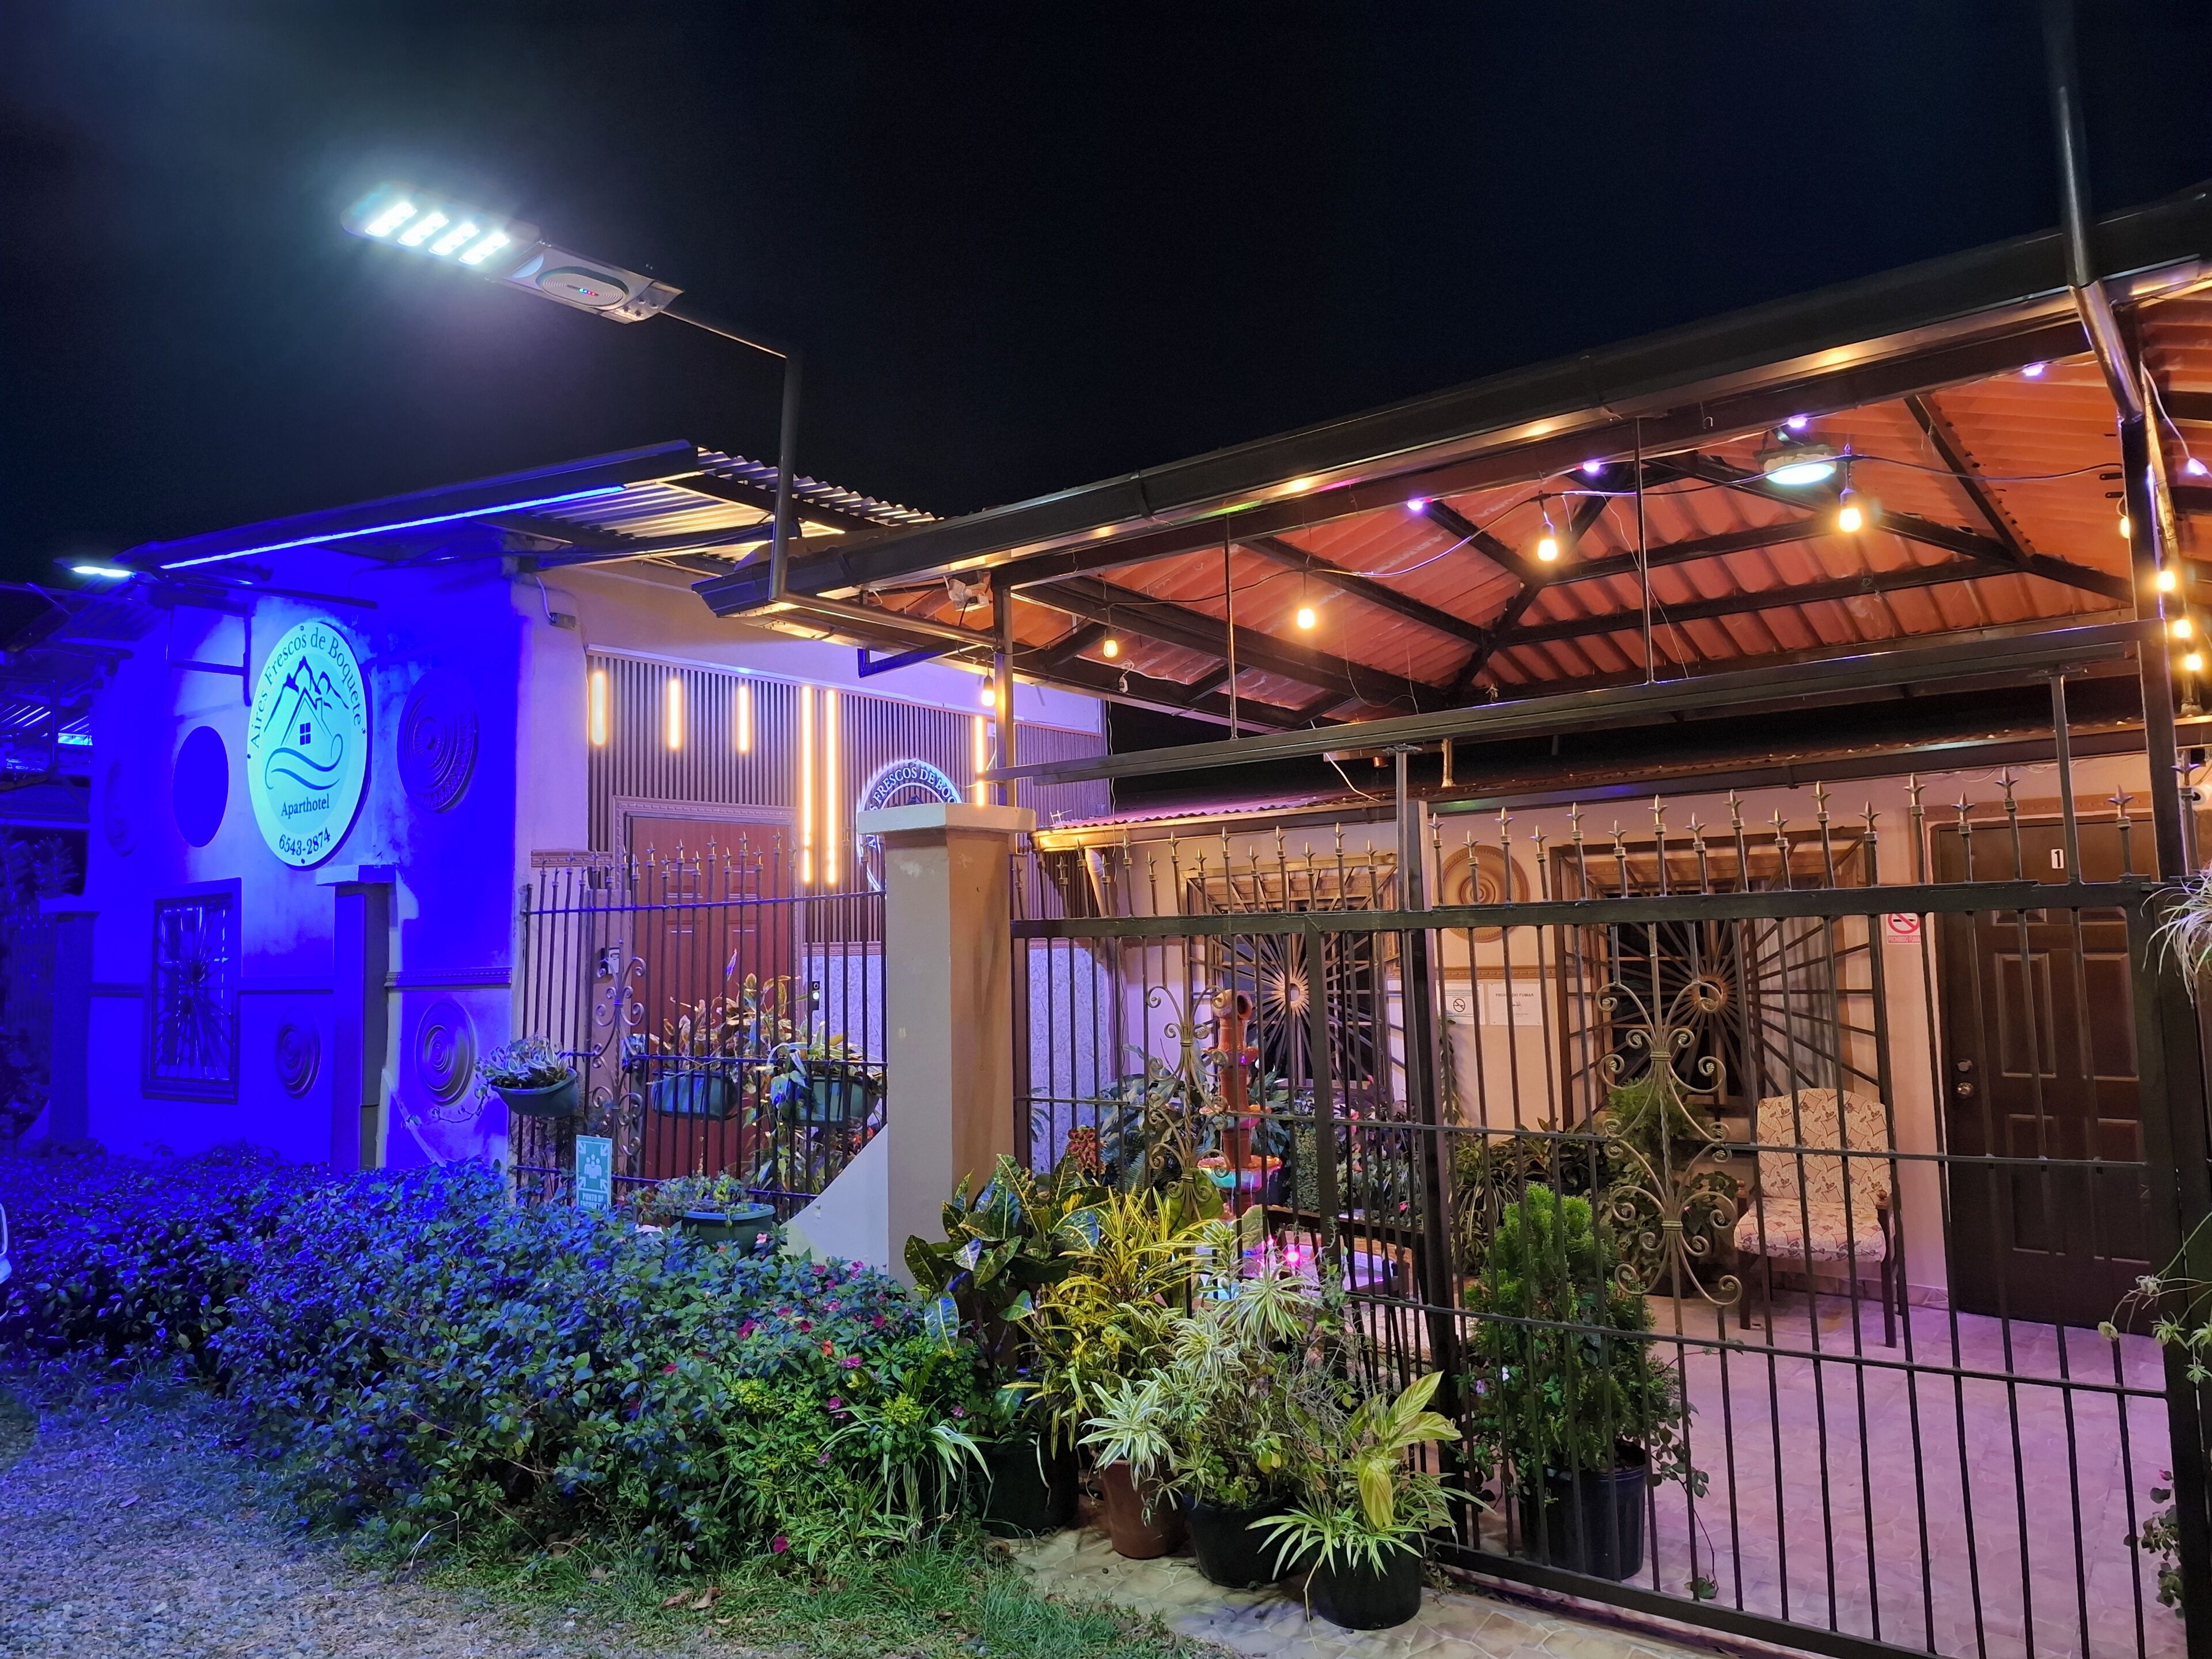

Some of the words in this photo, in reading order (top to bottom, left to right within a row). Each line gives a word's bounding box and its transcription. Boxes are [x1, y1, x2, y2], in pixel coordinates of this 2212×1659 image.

[250, 689, 268, 749] Aires
[264, 633, 308, 687] Frescos
[310, 627, 327, 650] de
[327, 635, 362, 727] Boquete
[872, 766, 918, 804] FRESCOS
[919, 767, 935, 786] DE
[280, 793, 331, 819] Aparthotel
[278, 826, 331, 857] 6543-2874
[2054, 850, 2061, 868] 1
[582, 1192, 597, 1202] PUNTO
